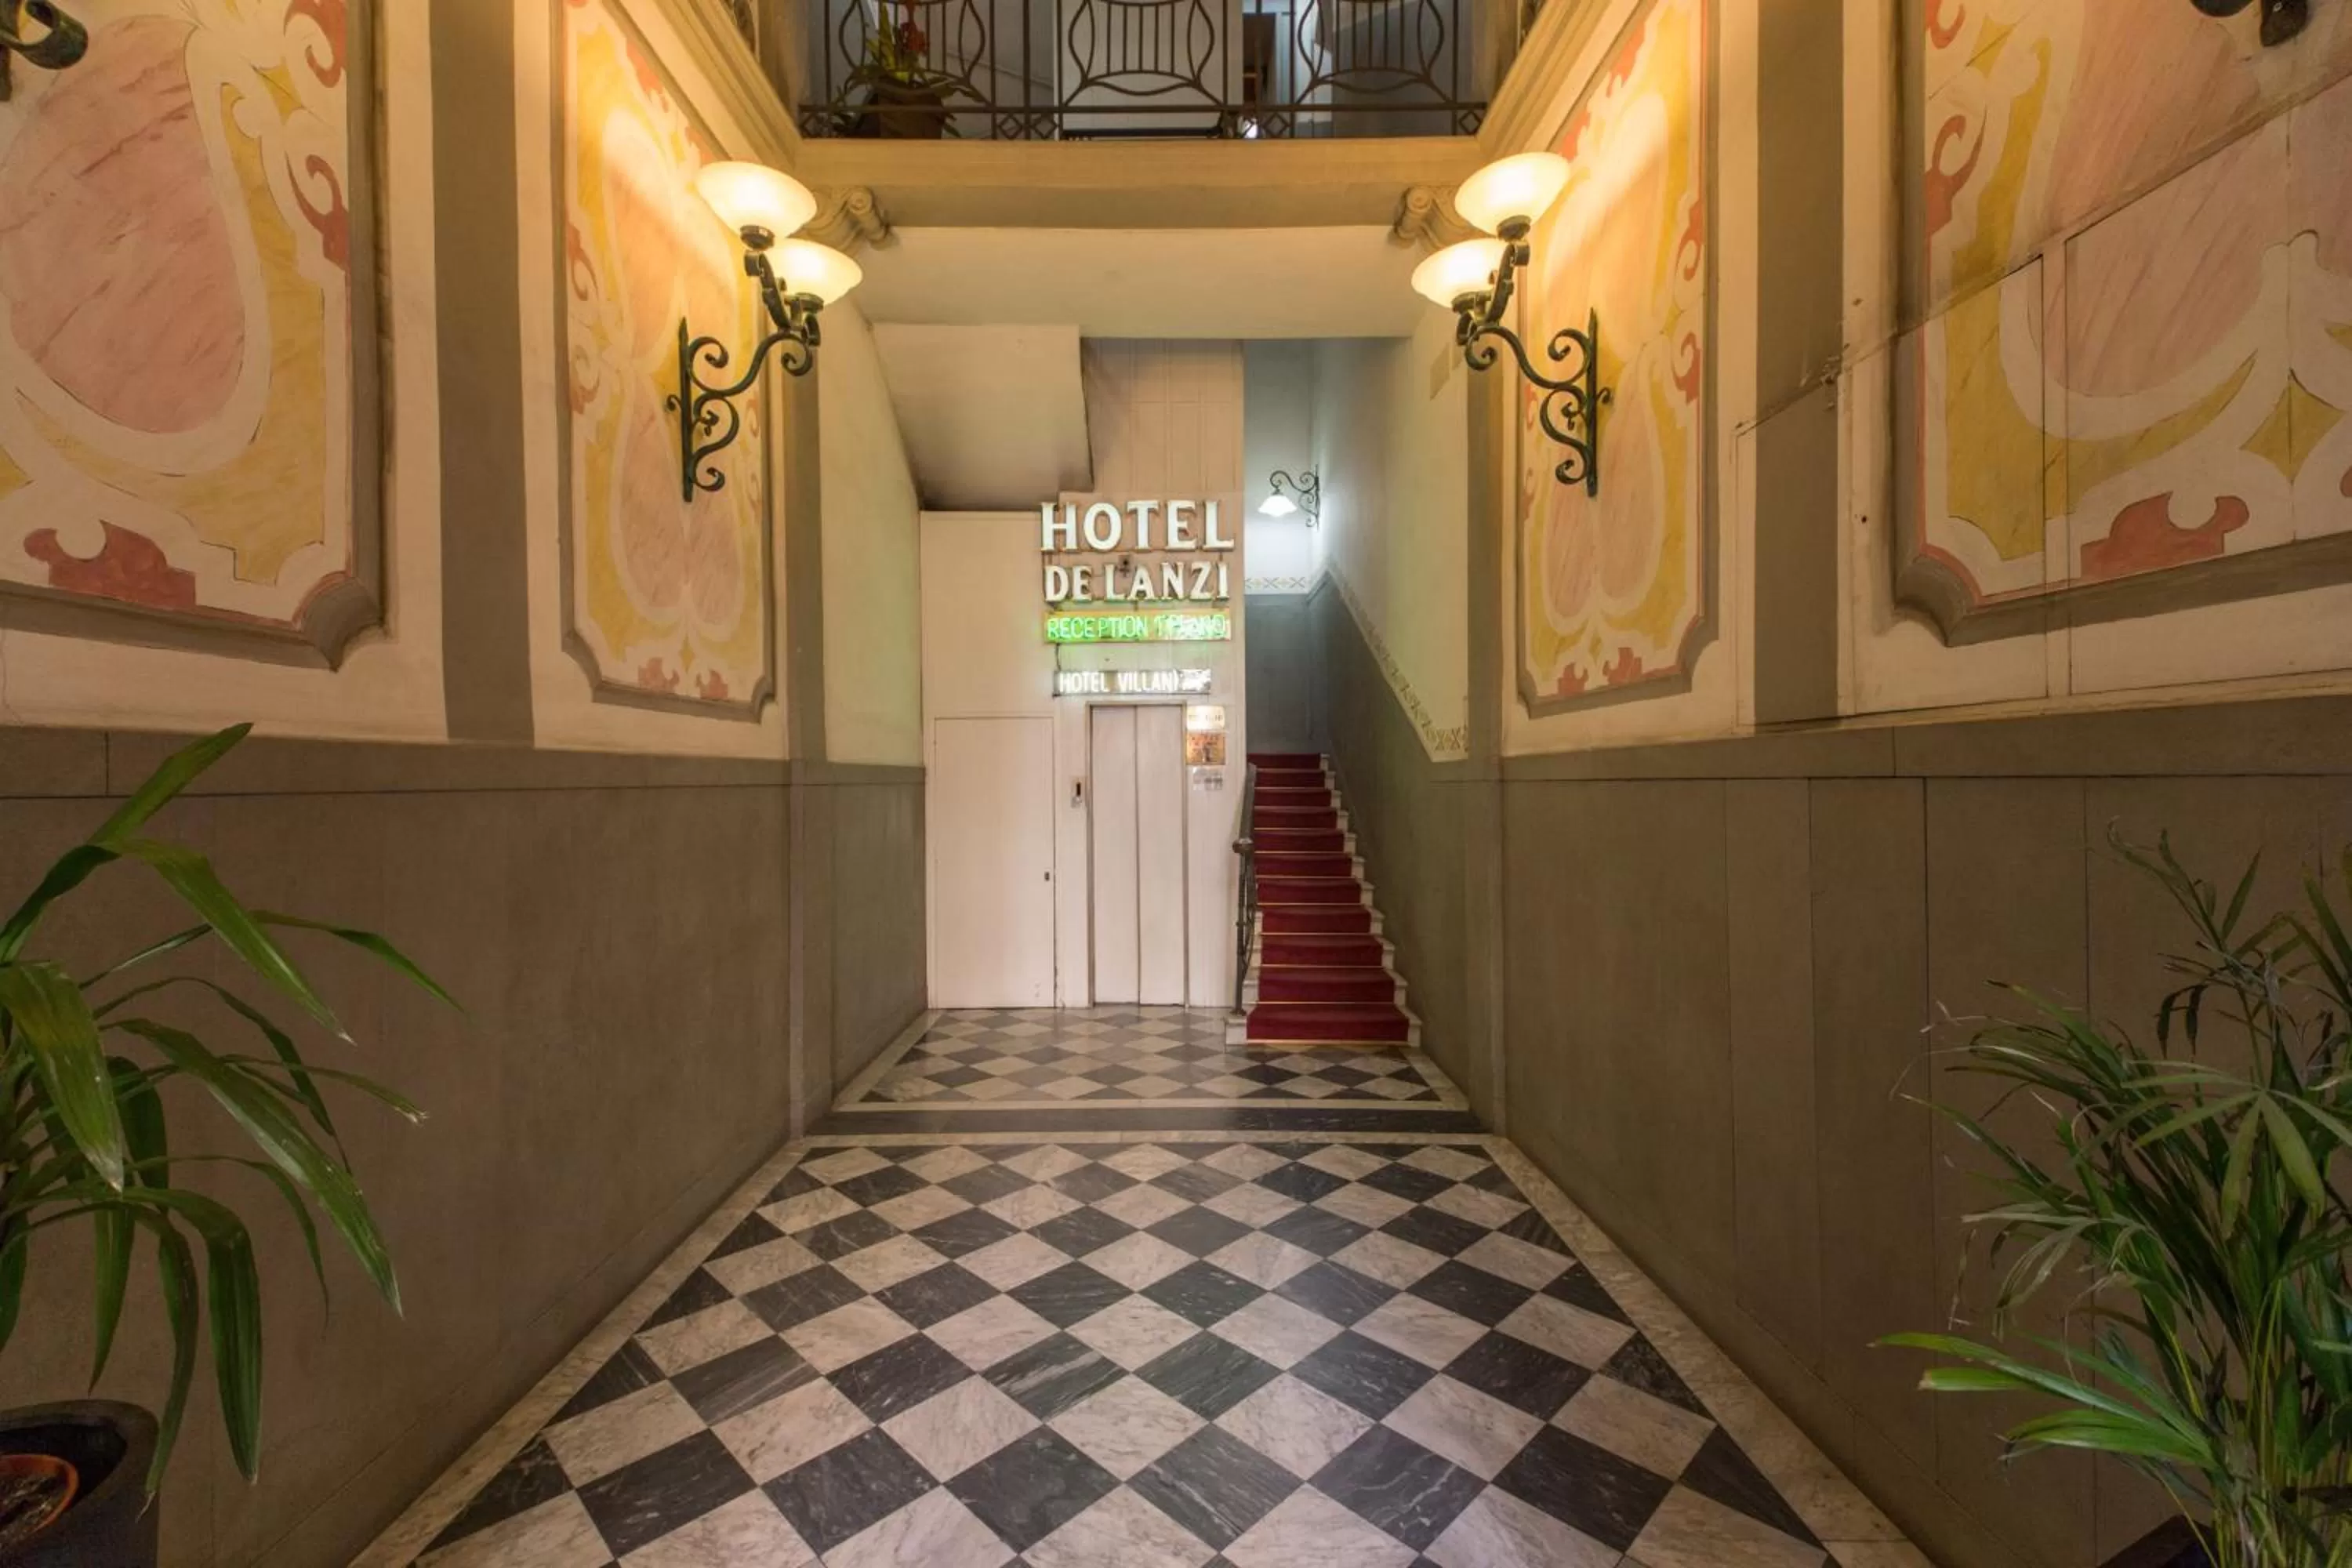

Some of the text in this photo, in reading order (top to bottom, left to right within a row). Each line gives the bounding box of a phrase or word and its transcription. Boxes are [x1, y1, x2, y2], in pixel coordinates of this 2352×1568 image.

[1040, 499, 1235, 551] HOTEL
[1044, 561, 1230, 602] DE LANZI
[1047, 615, 1148, 638] RECEPTION
[1059, 672, 1109, 692] HOTEL
